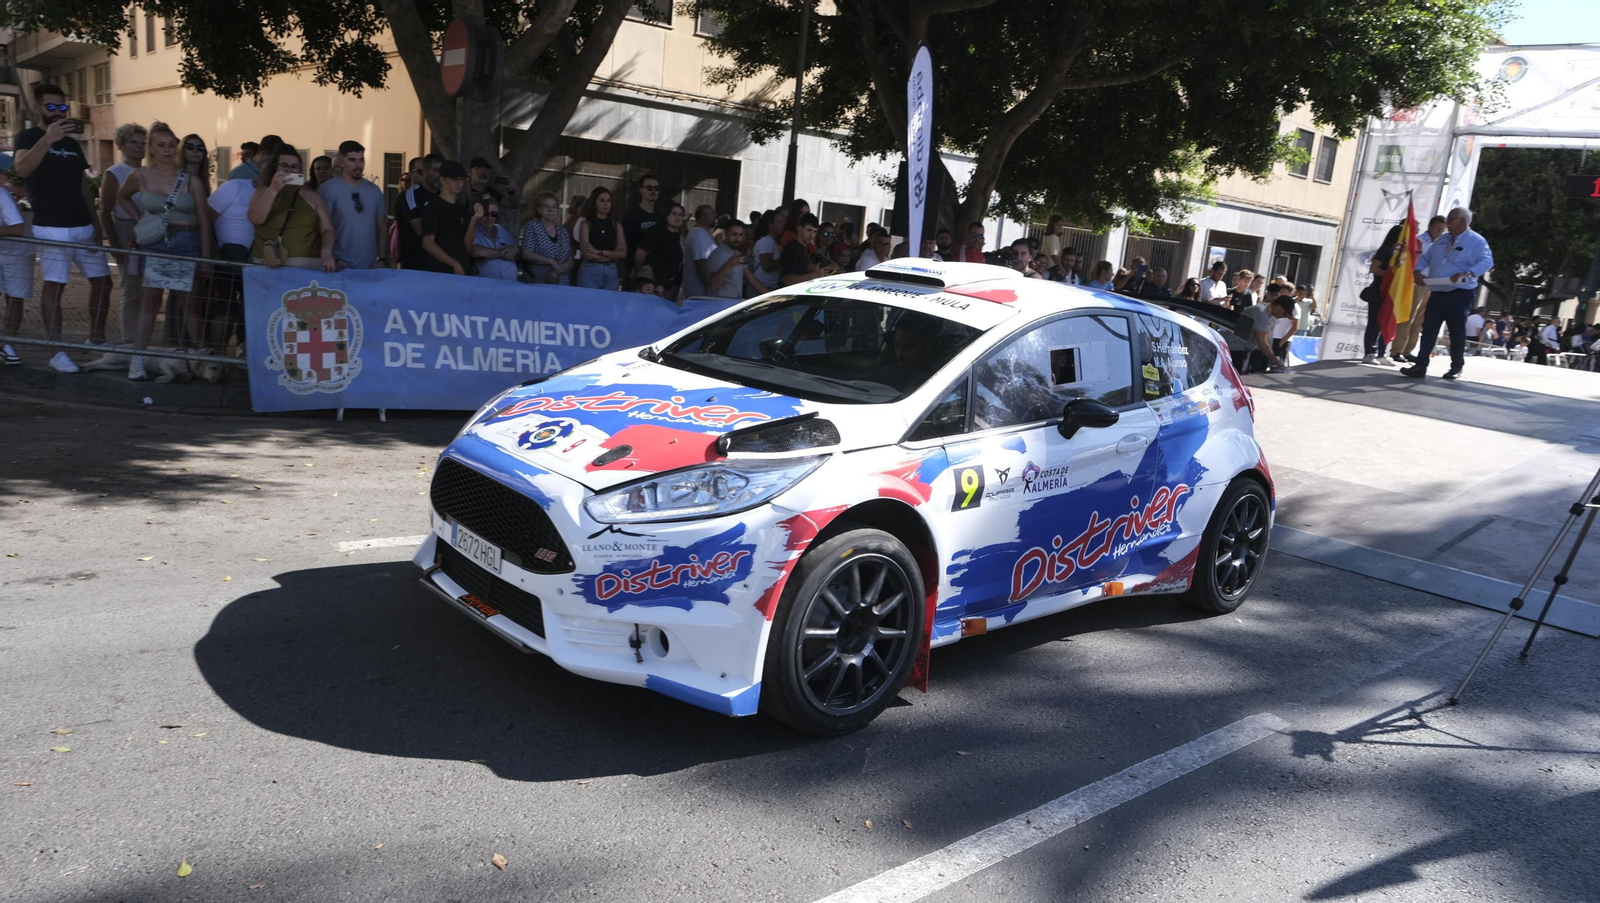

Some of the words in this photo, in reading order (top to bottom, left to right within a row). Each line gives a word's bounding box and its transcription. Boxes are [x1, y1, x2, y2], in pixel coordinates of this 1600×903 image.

[930, 295, 972, 311] MULA
[383, 308, 612, 349] AYUNTAMIENTO
[383, 341, 425, 368] DE
[434, 347, 563, 375] ALMERÍA
[497, 391, 773, 423] Distriver
[960, 468, 979, 508] 9
[1031, 475, 1069, 494] ALMERÍA
[1007, 485, 1190, 603] Distriver
[594, 550, 750, 600] Distriver
